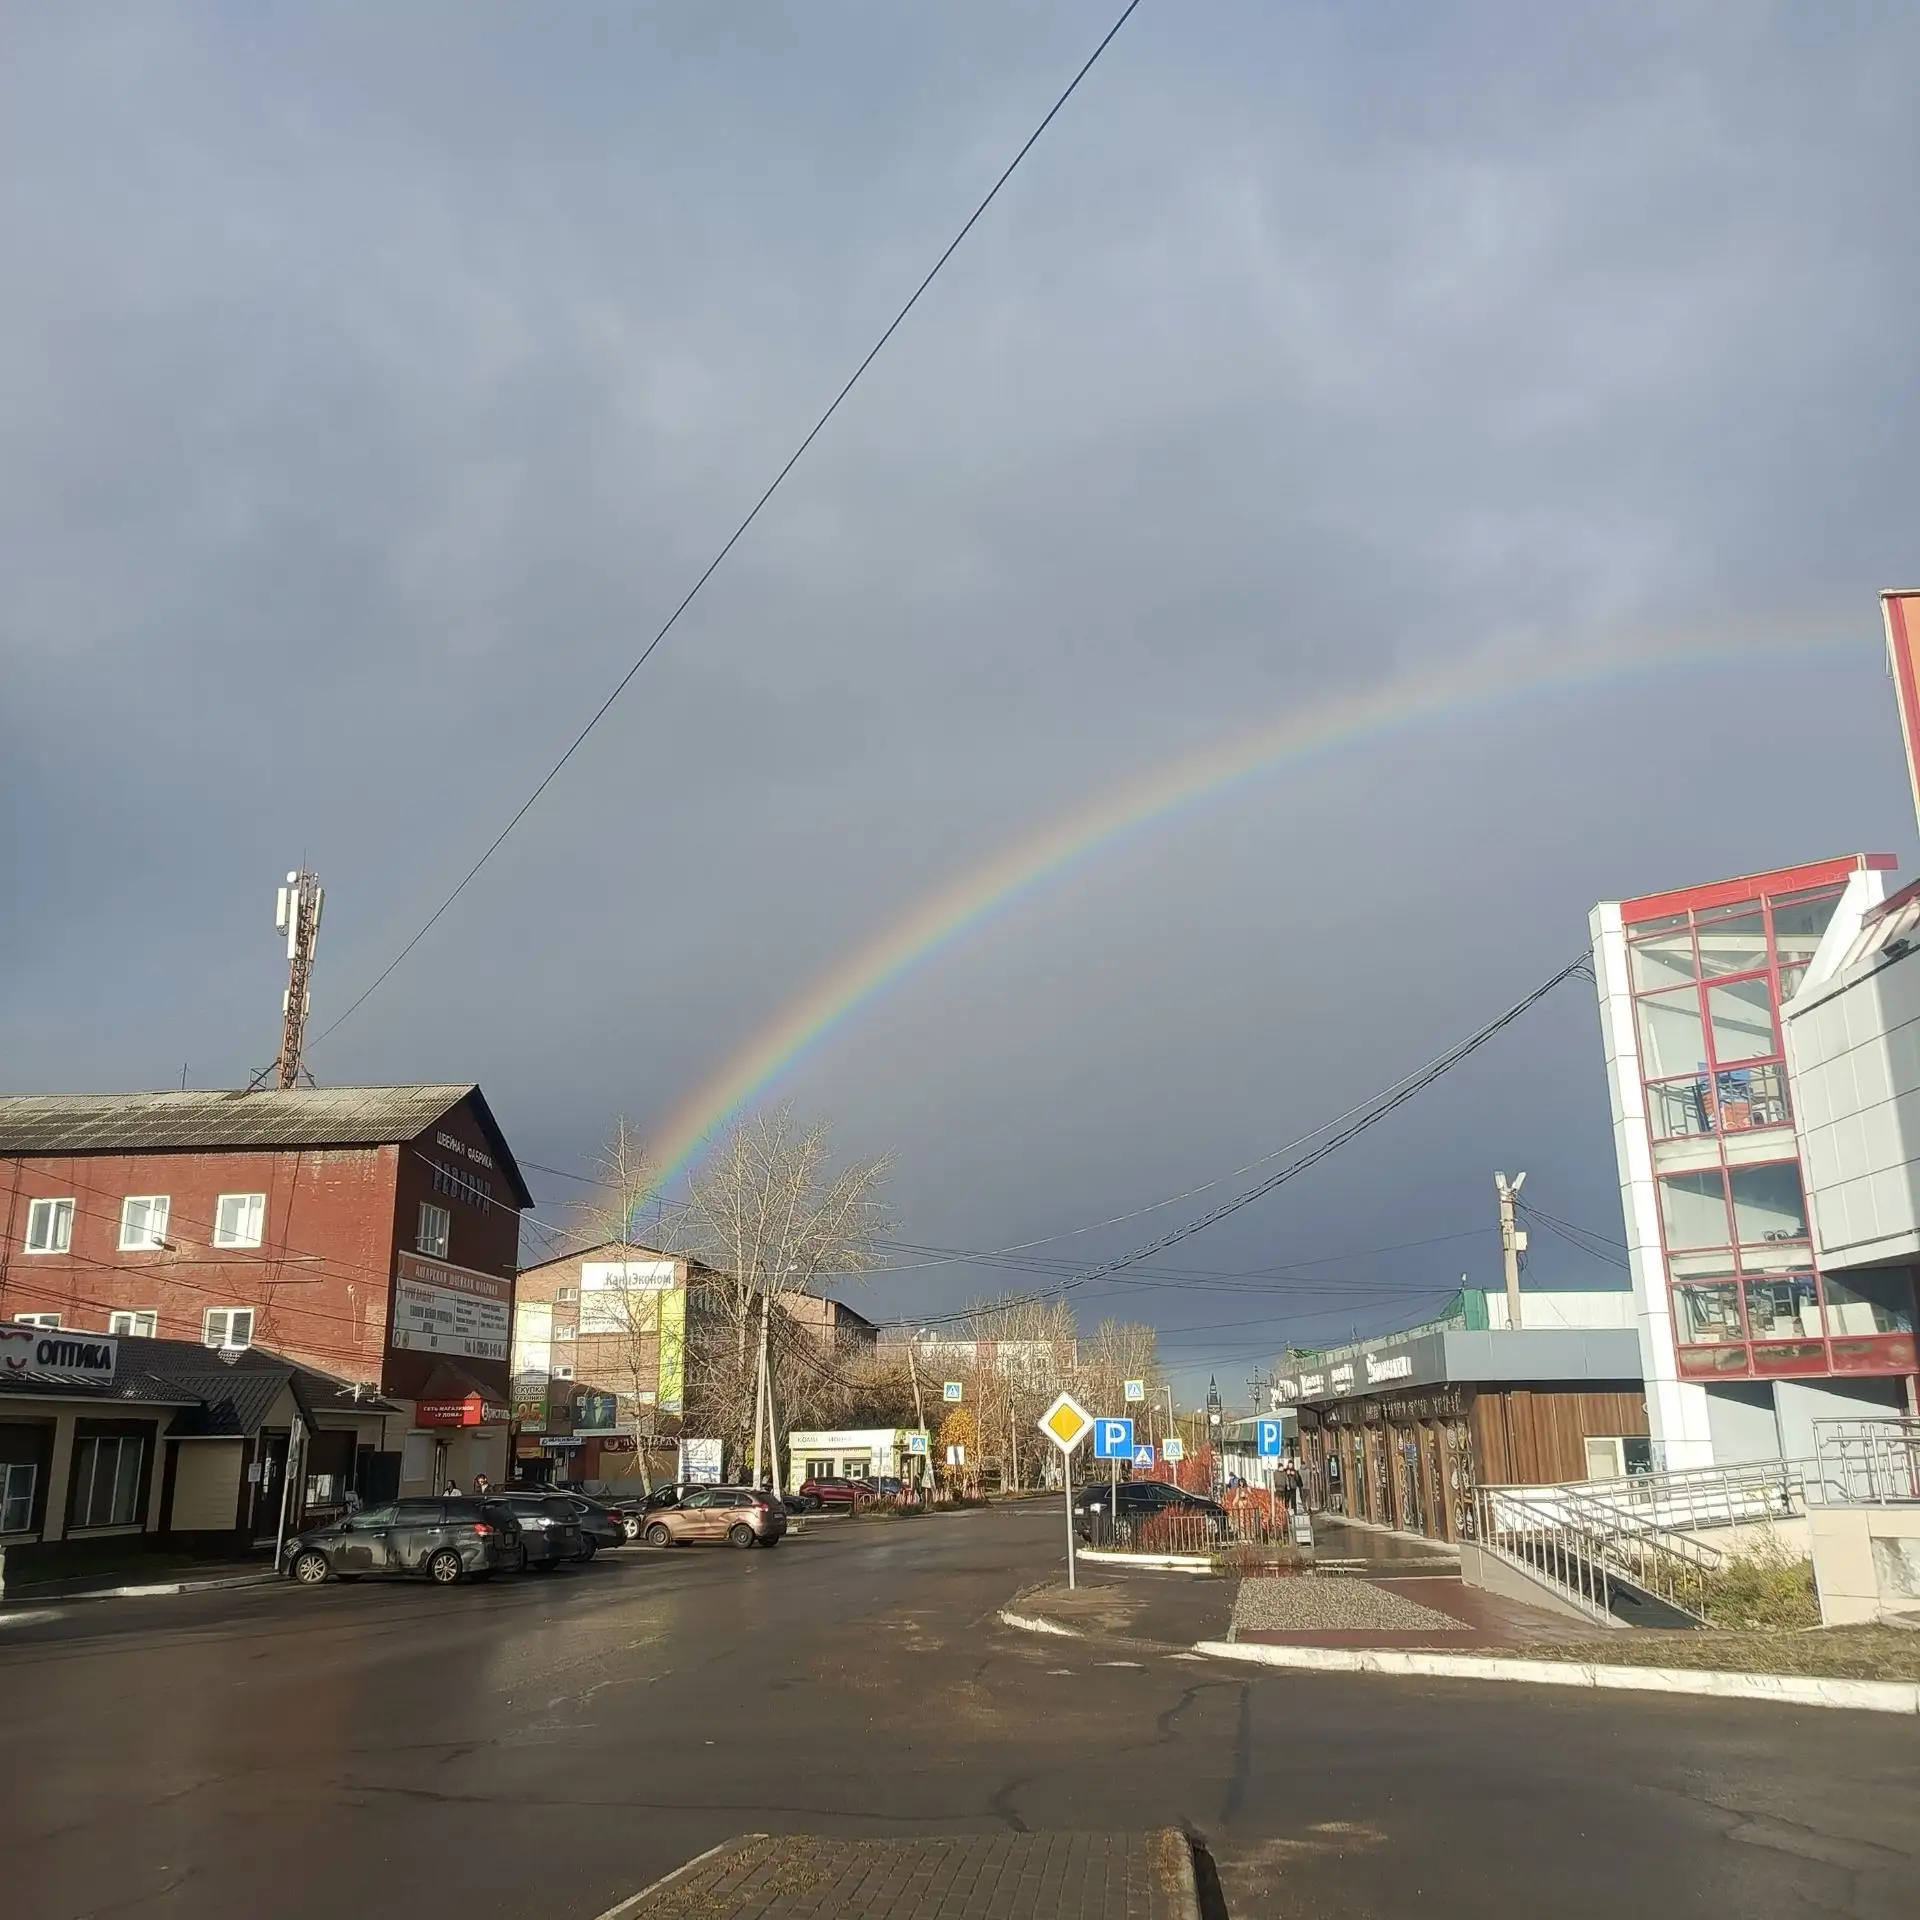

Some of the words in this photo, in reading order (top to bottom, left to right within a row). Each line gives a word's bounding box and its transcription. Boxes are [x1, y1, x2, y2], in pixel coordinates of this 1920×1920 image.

[436, 1130, 465, 1156] ШВЕЙНАЯ
[467, 1147, 493, 1170] ФАБРИКА
[36, 1339, 112, 1370] ОПТИКА
[515, 1385, 545, 1395] СКУПКА
[1105, 1422, 1126, 1454] P
[1263, 1423, 1278, 1452] P
